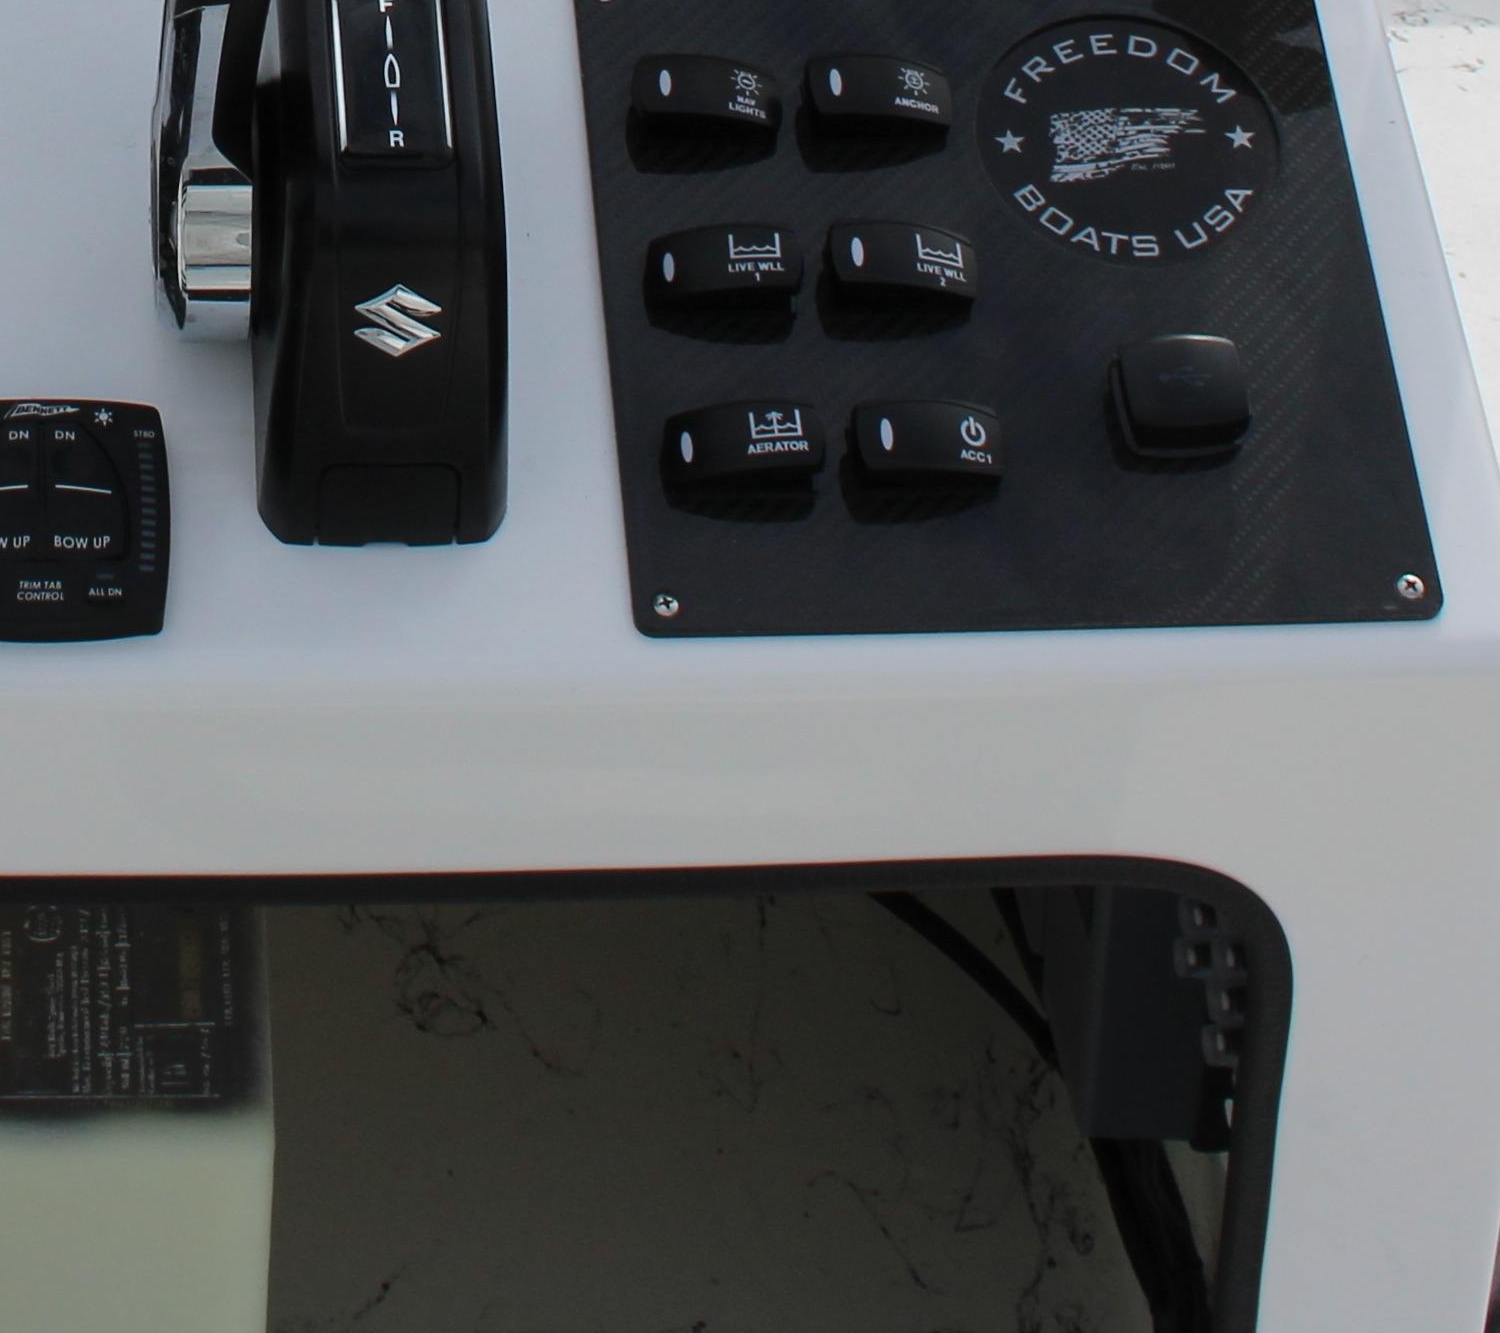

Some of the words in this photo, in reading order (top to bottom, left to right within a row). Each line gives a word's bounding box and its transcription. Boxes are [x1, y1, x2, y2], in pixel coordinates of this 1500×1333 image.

[1004, 34, 1237, 104] FREEDOM
[736, 95, 756, 106] NAV
[895, 96, 940, 115] ANCHOR
[728, 102, 767, 120] LIGHTS
[388, 130, 405, 147] R
[1013, 184, 1160, 257] BOATS
[1173, 188, 1254, 250] USA
[728, 263, 756, 273] LIVE
[758, 261, 785, 271] WLL
[916, 262, 943, 277] LIVE
[943, 267, 967, 283] WLL
[939, 276, 947, 287] 2
[12, 404, 72, 416] BENNETT
[8, 430, 30, 440] DN
[55, 430, 75, 441] DN
[133, 430, 155, 438] STBD
[747, 440, 809, 455] AERATOR
[12, 535, 31, 548] UP
[53, 535, 89, 549] BOW
[93, 535, 111, 549] UP
[18, 580, 41, 590] TRIM
[43, 580, 62, 590] TAB
[16, 591, 65, 601] CONTROL
[88, 587, 104, 596] ALL
[105, 587, 123, 597] DN
